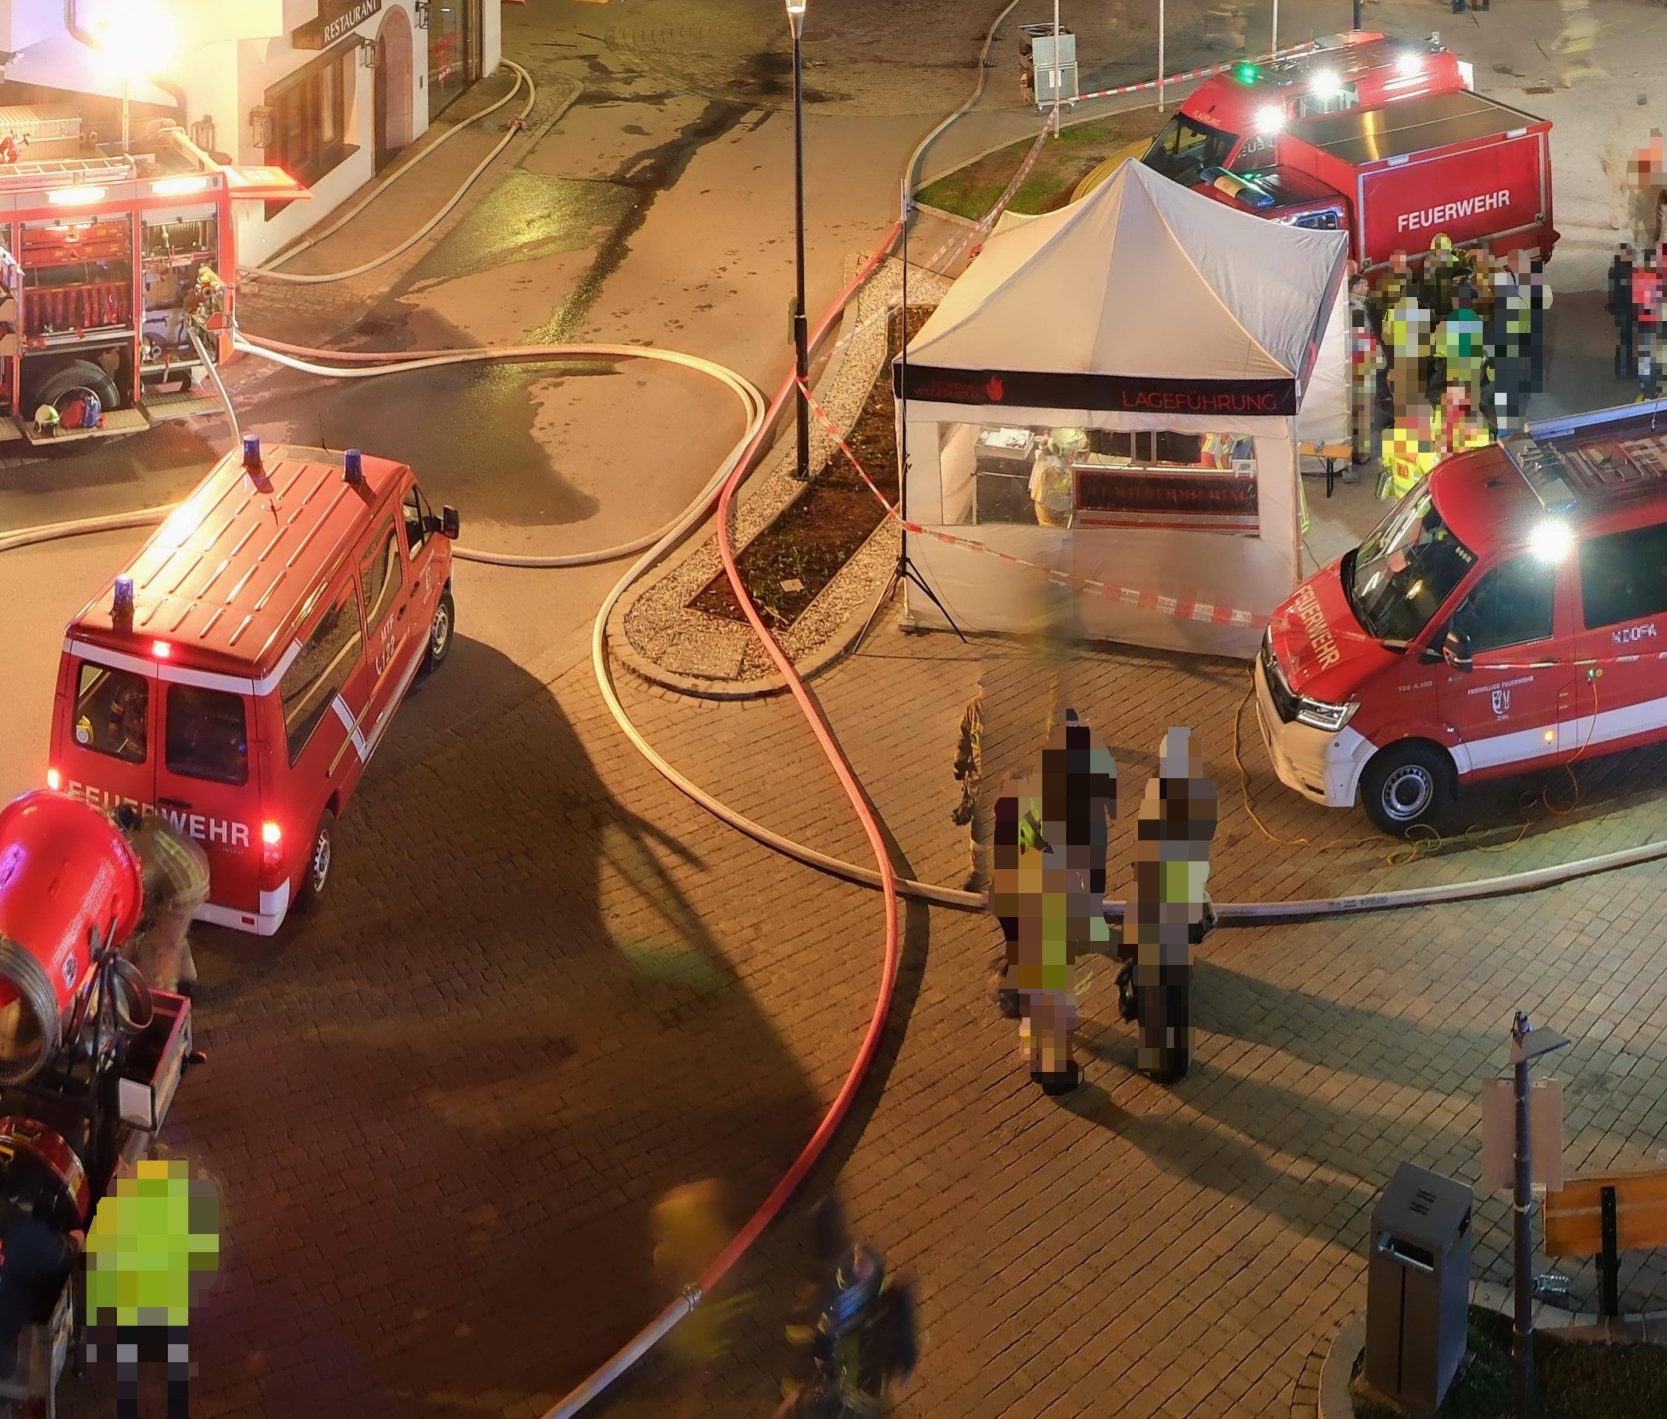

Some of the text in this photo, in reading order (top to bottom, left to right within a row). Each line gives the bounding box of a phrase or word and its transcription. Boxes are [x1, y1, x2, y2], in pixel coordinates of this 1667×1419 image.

[1397, 190, 1510, 232] FEUERWEHR
[1122, 391, 1277, 412] LAGEFÜHRUNG
[1294, 584, 1341, 672] FEUERWEHR
[1467, 675, 1535, 696] FREIWILLIGE FEUERWEHR
